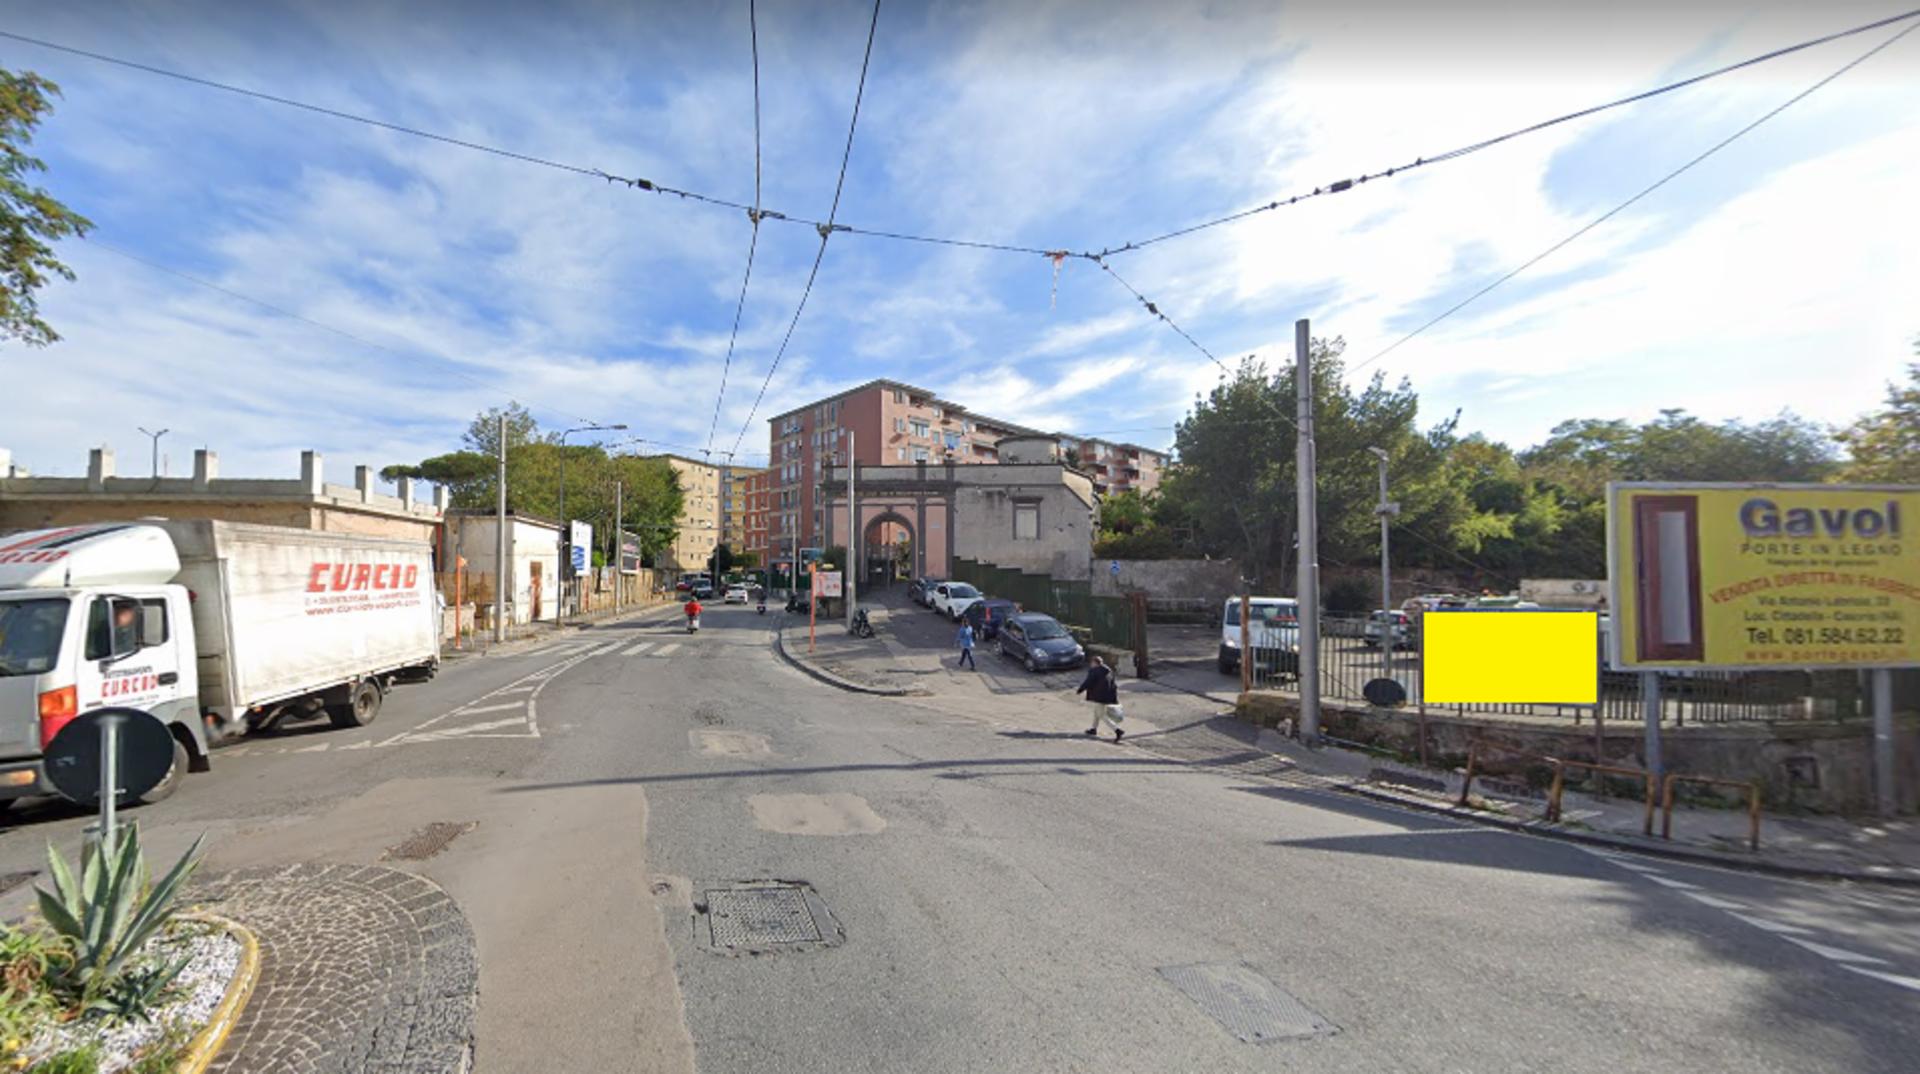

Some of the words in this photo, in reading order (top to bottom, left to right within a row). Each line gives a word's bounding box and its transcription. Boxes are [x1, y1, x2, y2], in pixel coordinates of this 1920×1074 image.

[1739, 498, 1901, 539] Gavol
[1740, 543, 1801, 555] PORTE
[1841, 543, 1902, 556] LEGNO
[305, 562, 418, 593] CURCIO
[102, 675, 159, 697] CURCIO
